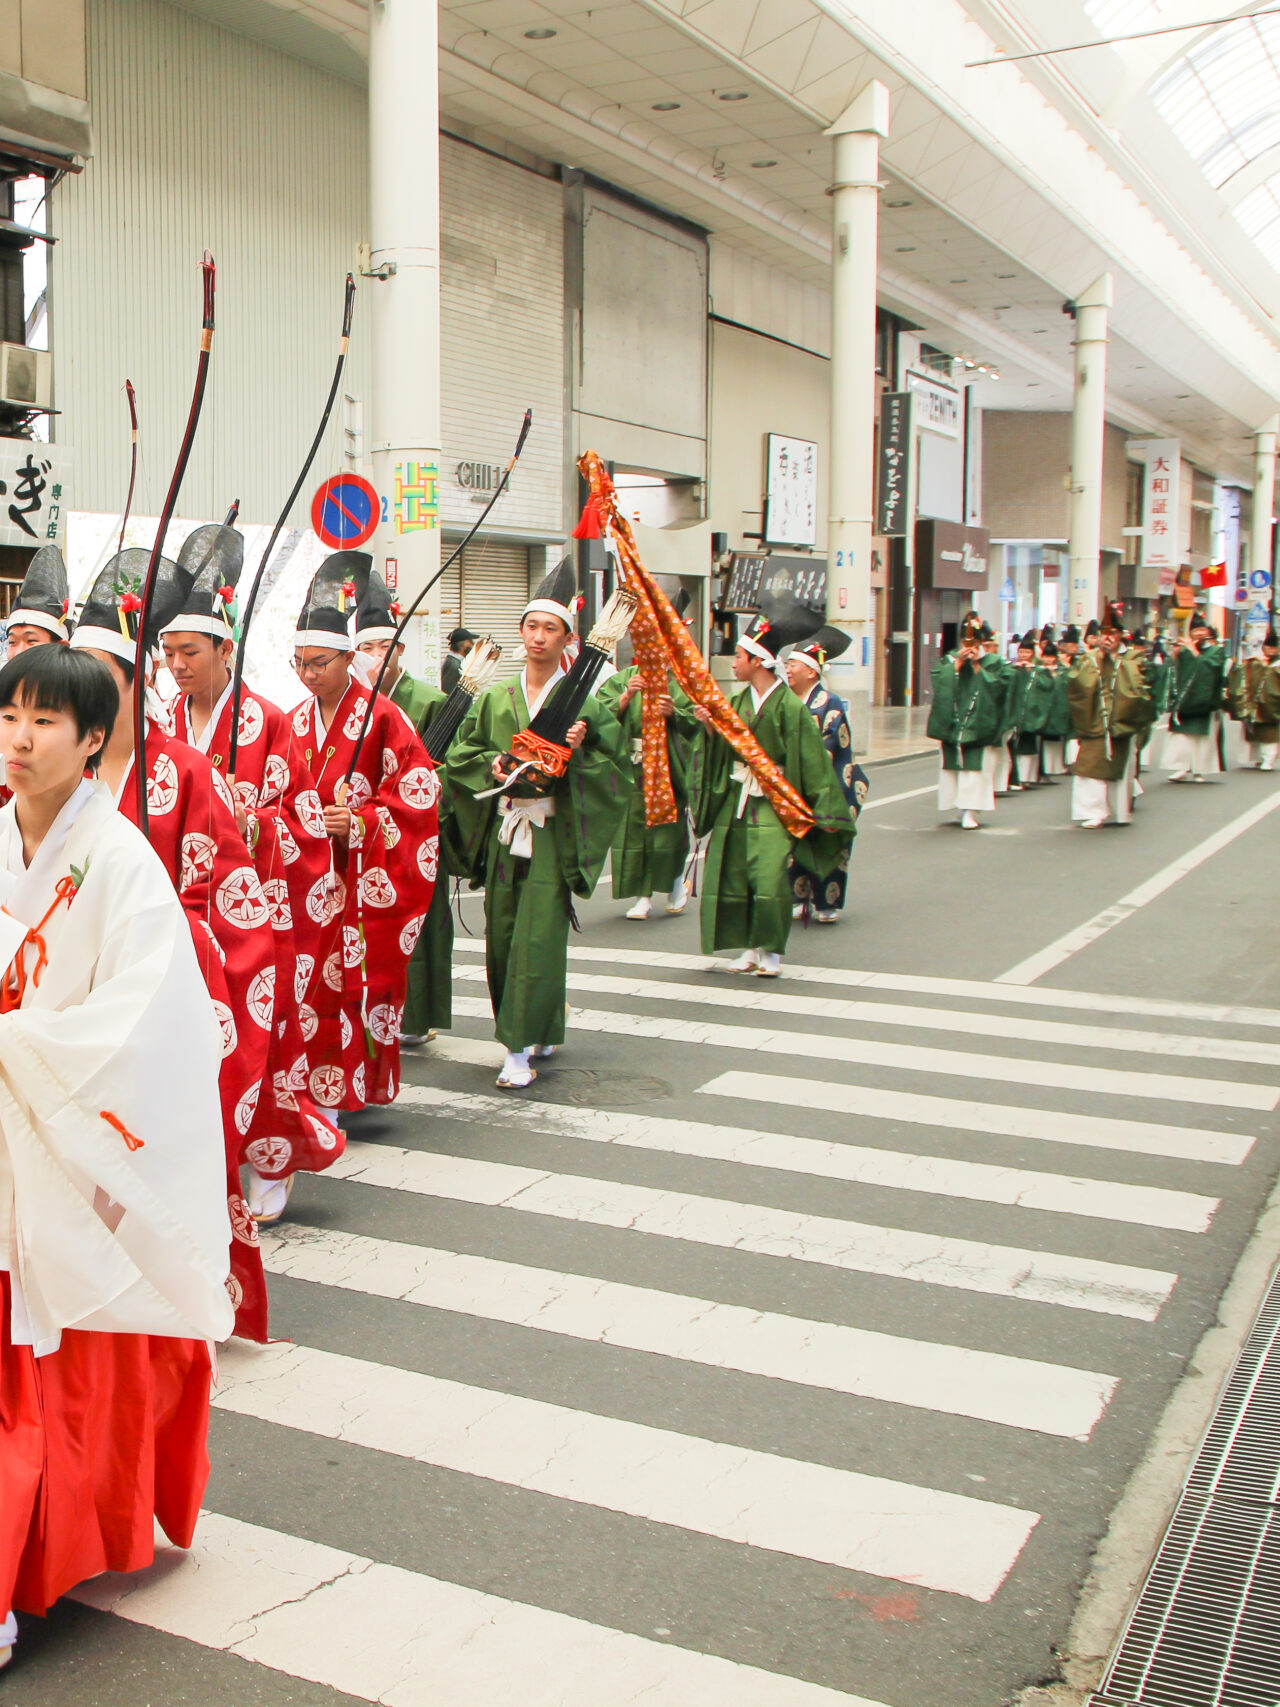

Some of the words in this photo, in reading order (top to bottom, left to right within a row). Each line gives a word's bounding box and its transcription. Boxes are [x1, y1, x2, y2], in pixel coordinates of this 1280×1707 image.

[45, 483, 62, 539] 専門店
[1151, 456, 1170, 536] 大和証券
